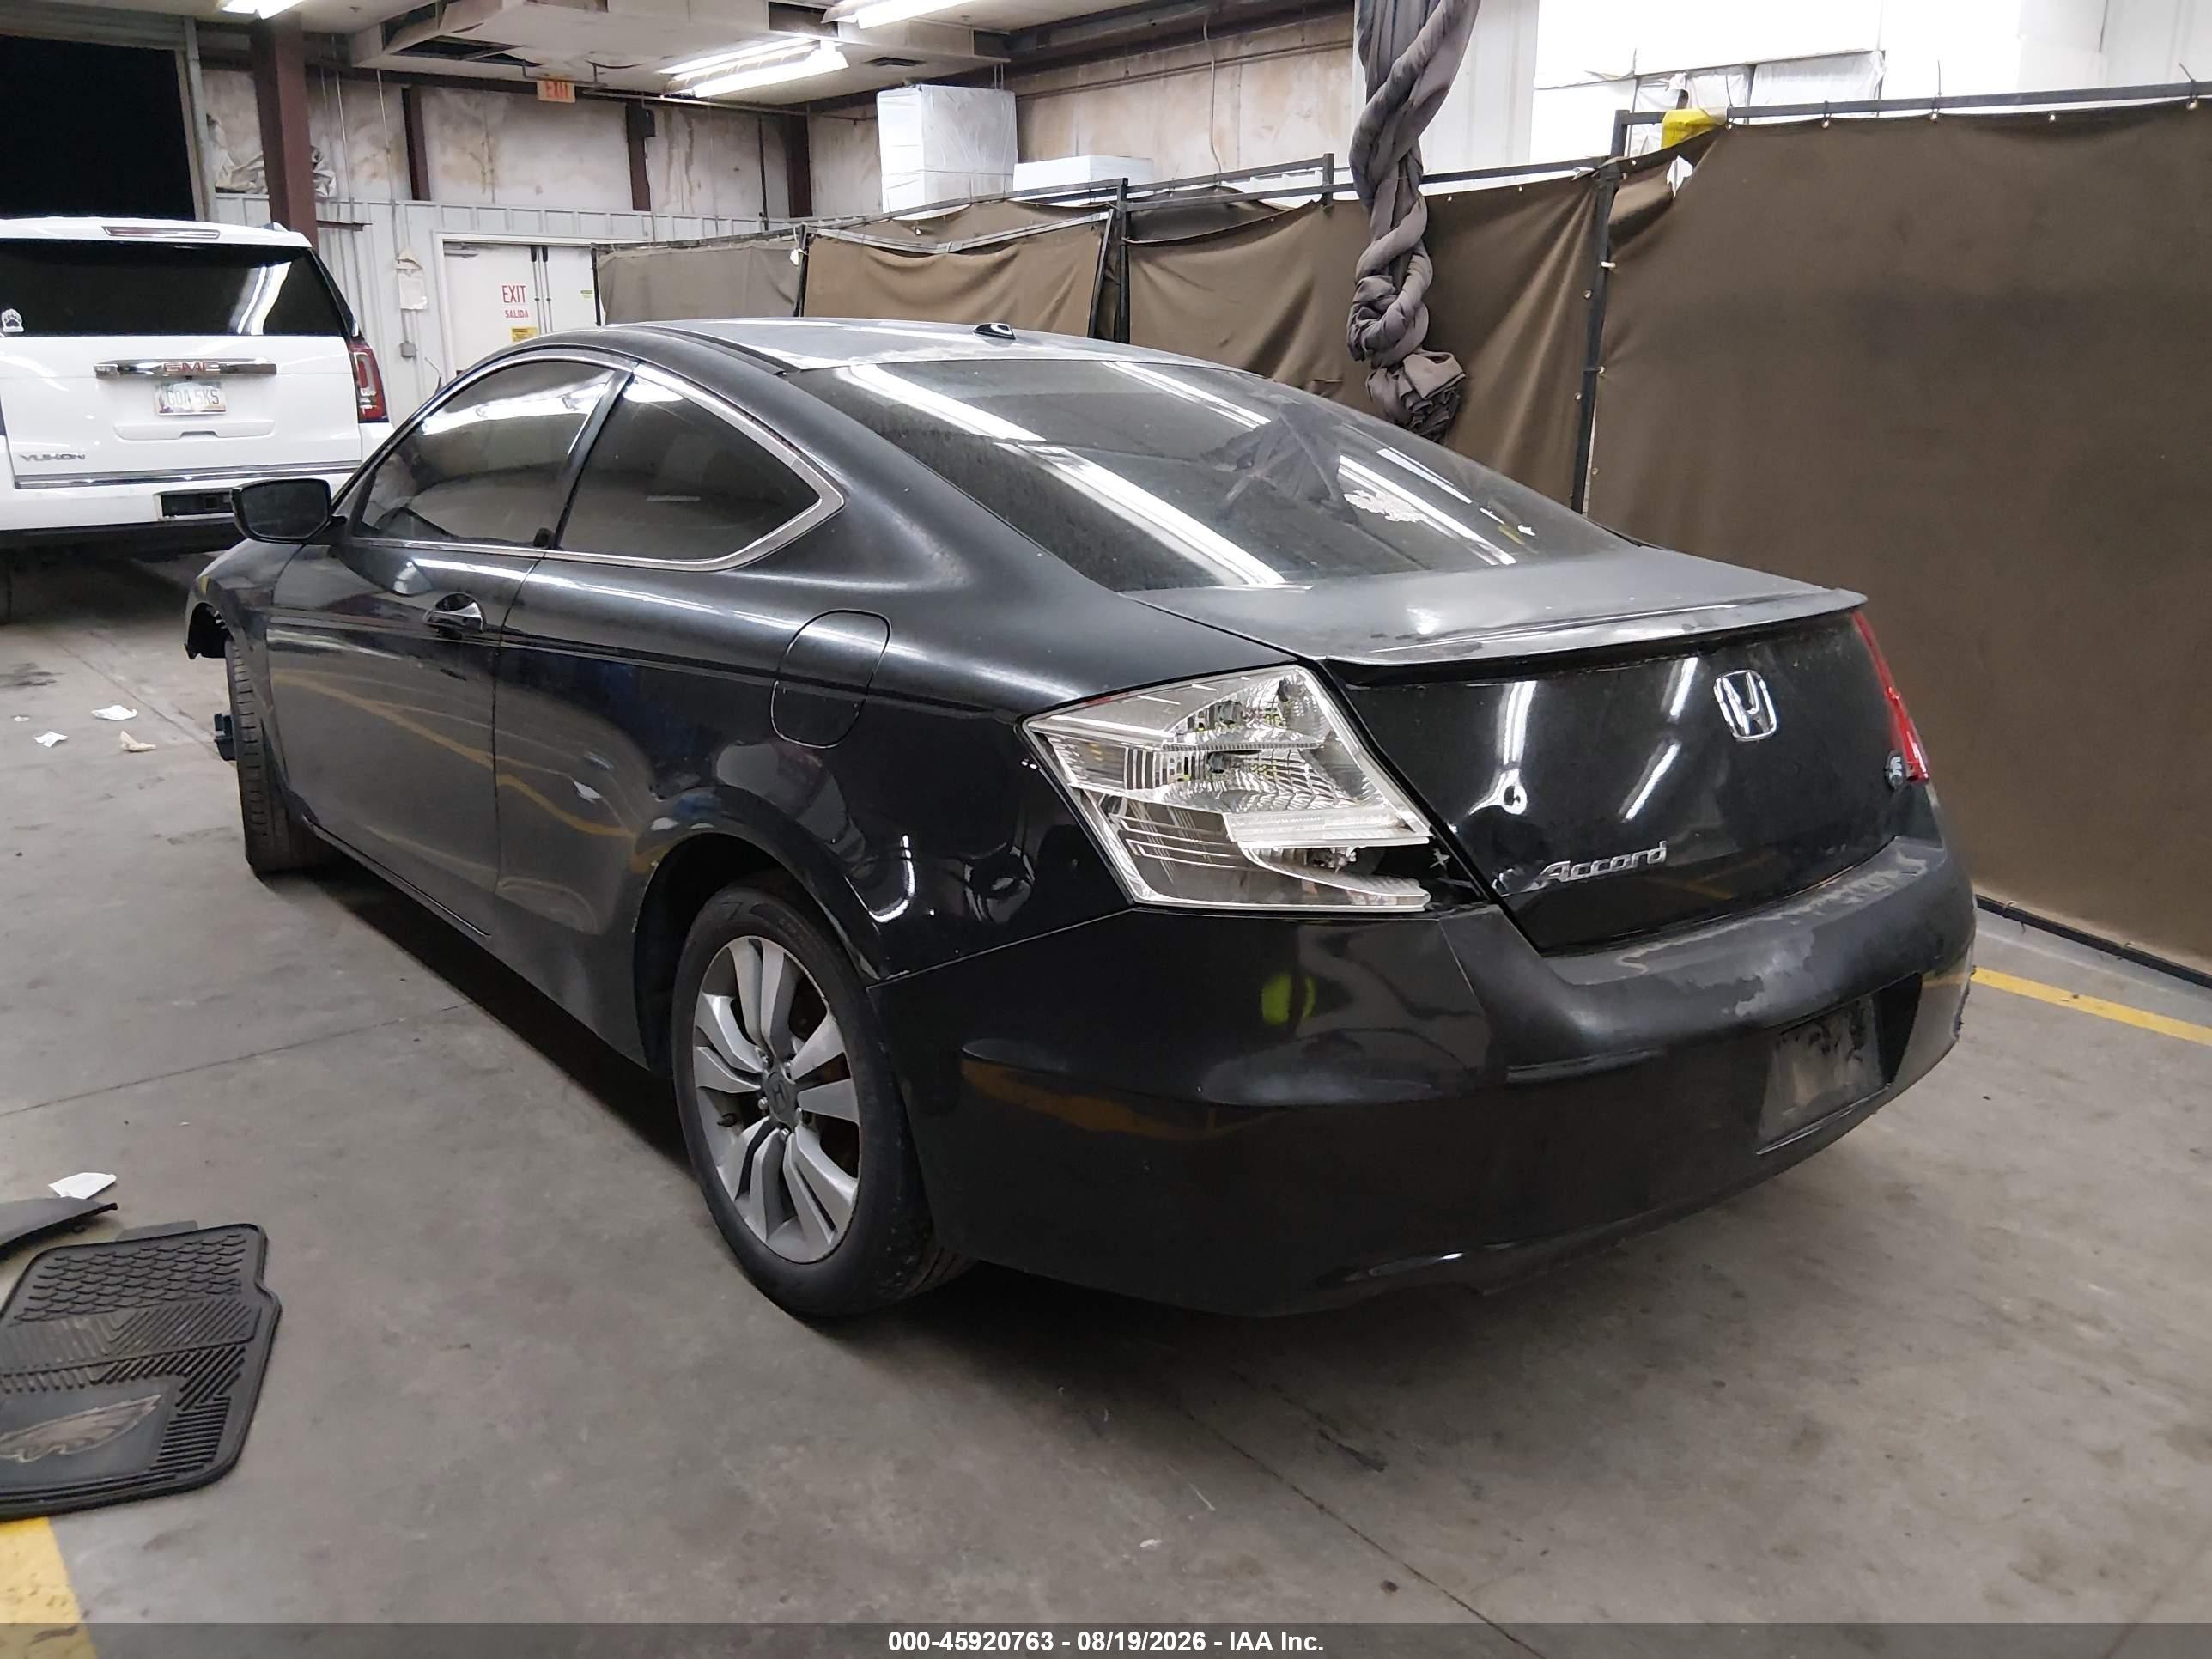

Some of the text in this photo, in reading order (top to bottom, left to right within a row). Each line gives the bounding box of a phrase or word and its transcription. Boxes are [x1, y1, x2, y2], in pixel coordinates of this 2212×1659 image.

[501, 284, 526, 303] EXIT
[504, 309, 529, 319] SALIDA
[163, 361, 221, 373] GMC
[20, 453, 86, 462] YUKON
[1532, 840, 1668, 887] Accord
